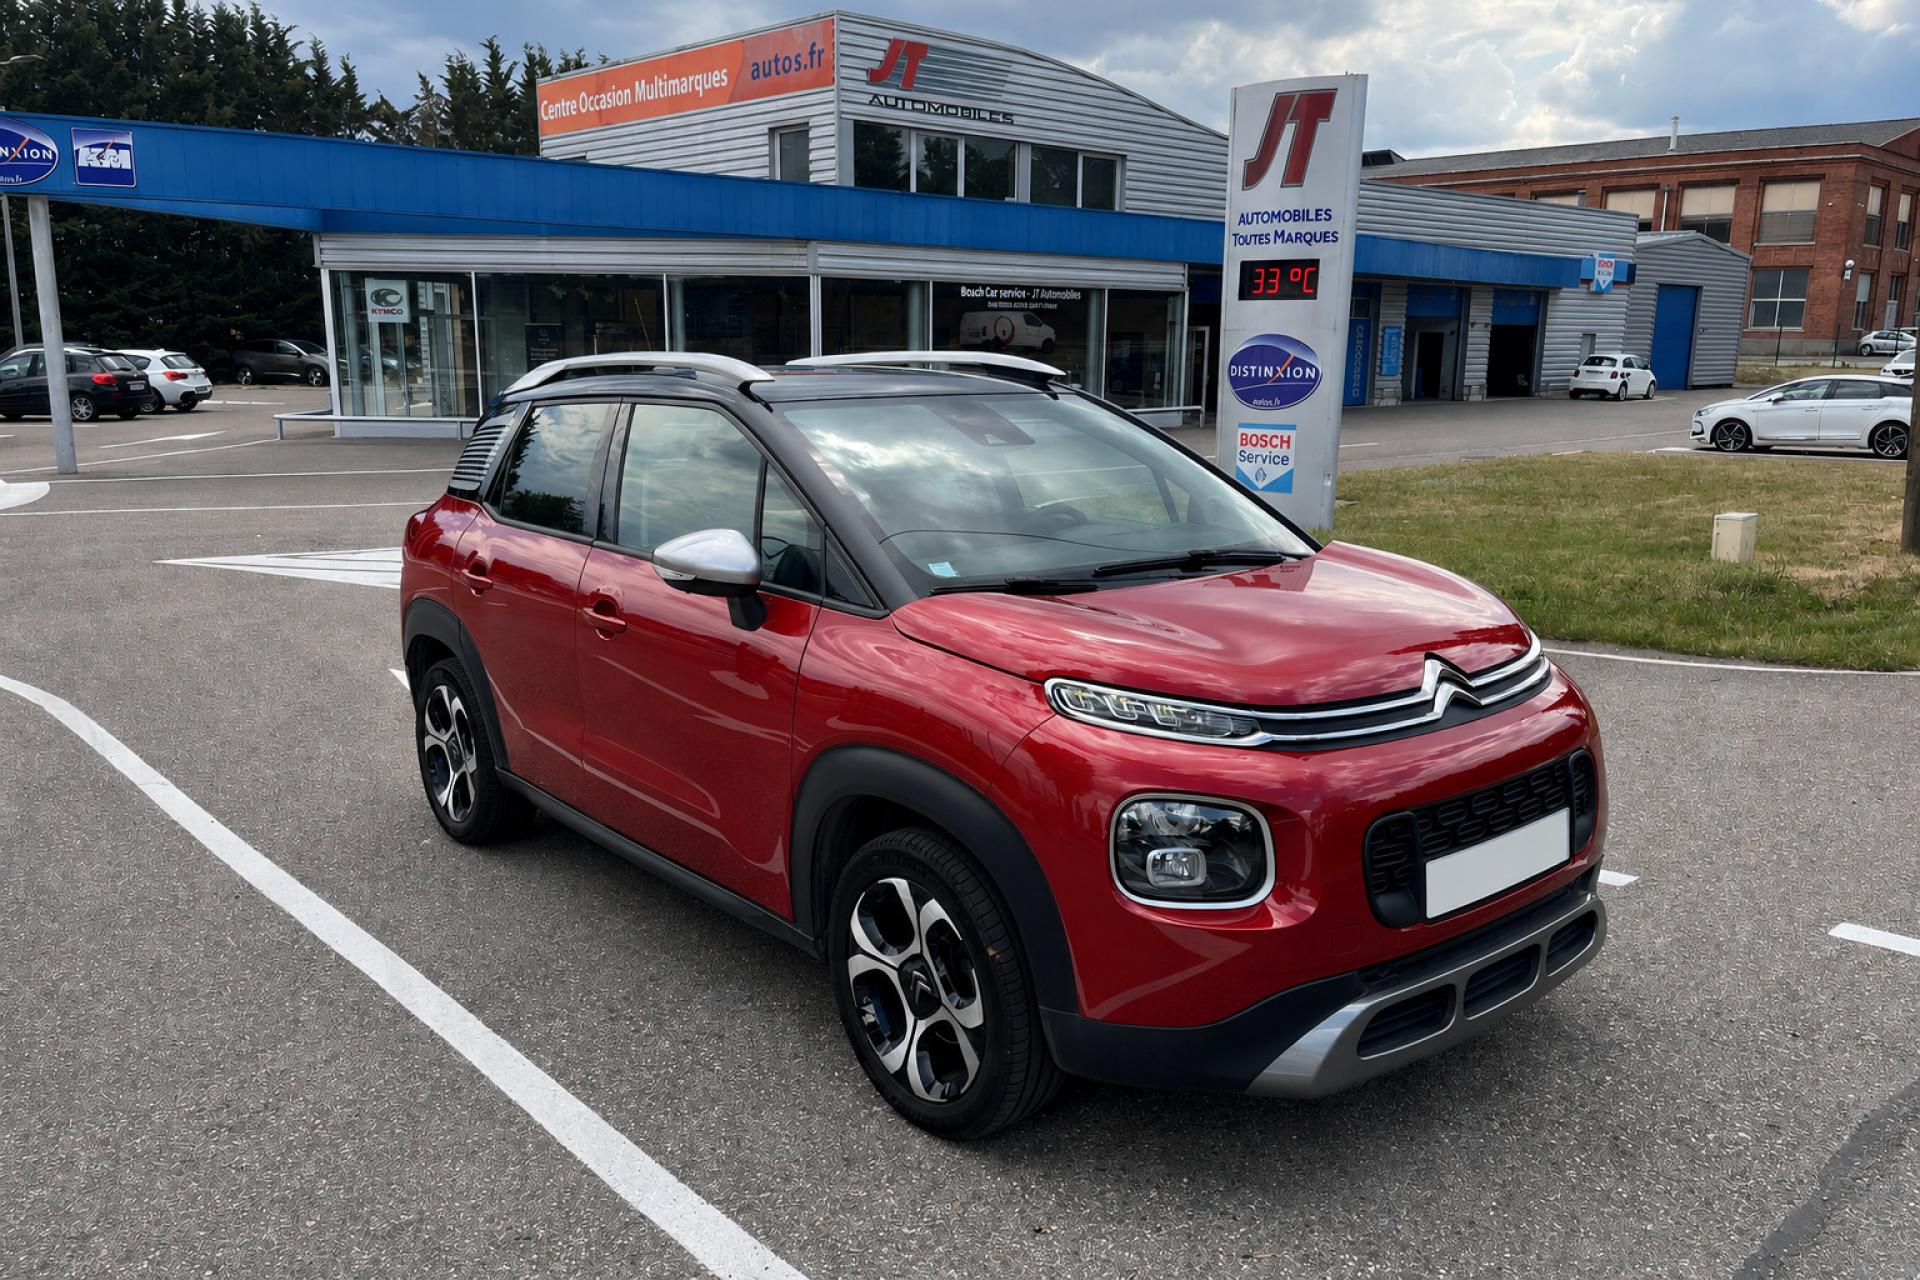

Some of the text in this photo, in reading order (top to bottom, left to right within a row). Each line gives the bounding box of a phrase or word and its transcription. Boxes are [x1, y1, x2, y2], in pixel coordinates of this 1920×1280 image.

[867, 36, 929, 90] JT
[541, 41, 825, 121] Centre Occasion Multimarques autos.fr
[869, 94, 1015, 125] AUTOMOBILES
[1242, 88, 1338, 190] JT
[1238, 208, 1333, 226] AUTOMOBILES
[961, 286, 984, 298] Bosch
[985, 286, 997, 298] Car
[1252, 268, 1281, 295] 33
[1230, 363, 1316, 379] DISTINXION
[1239, 432, 1291, 449] BOSCH
[1238, 450, 1290, 466] Service
